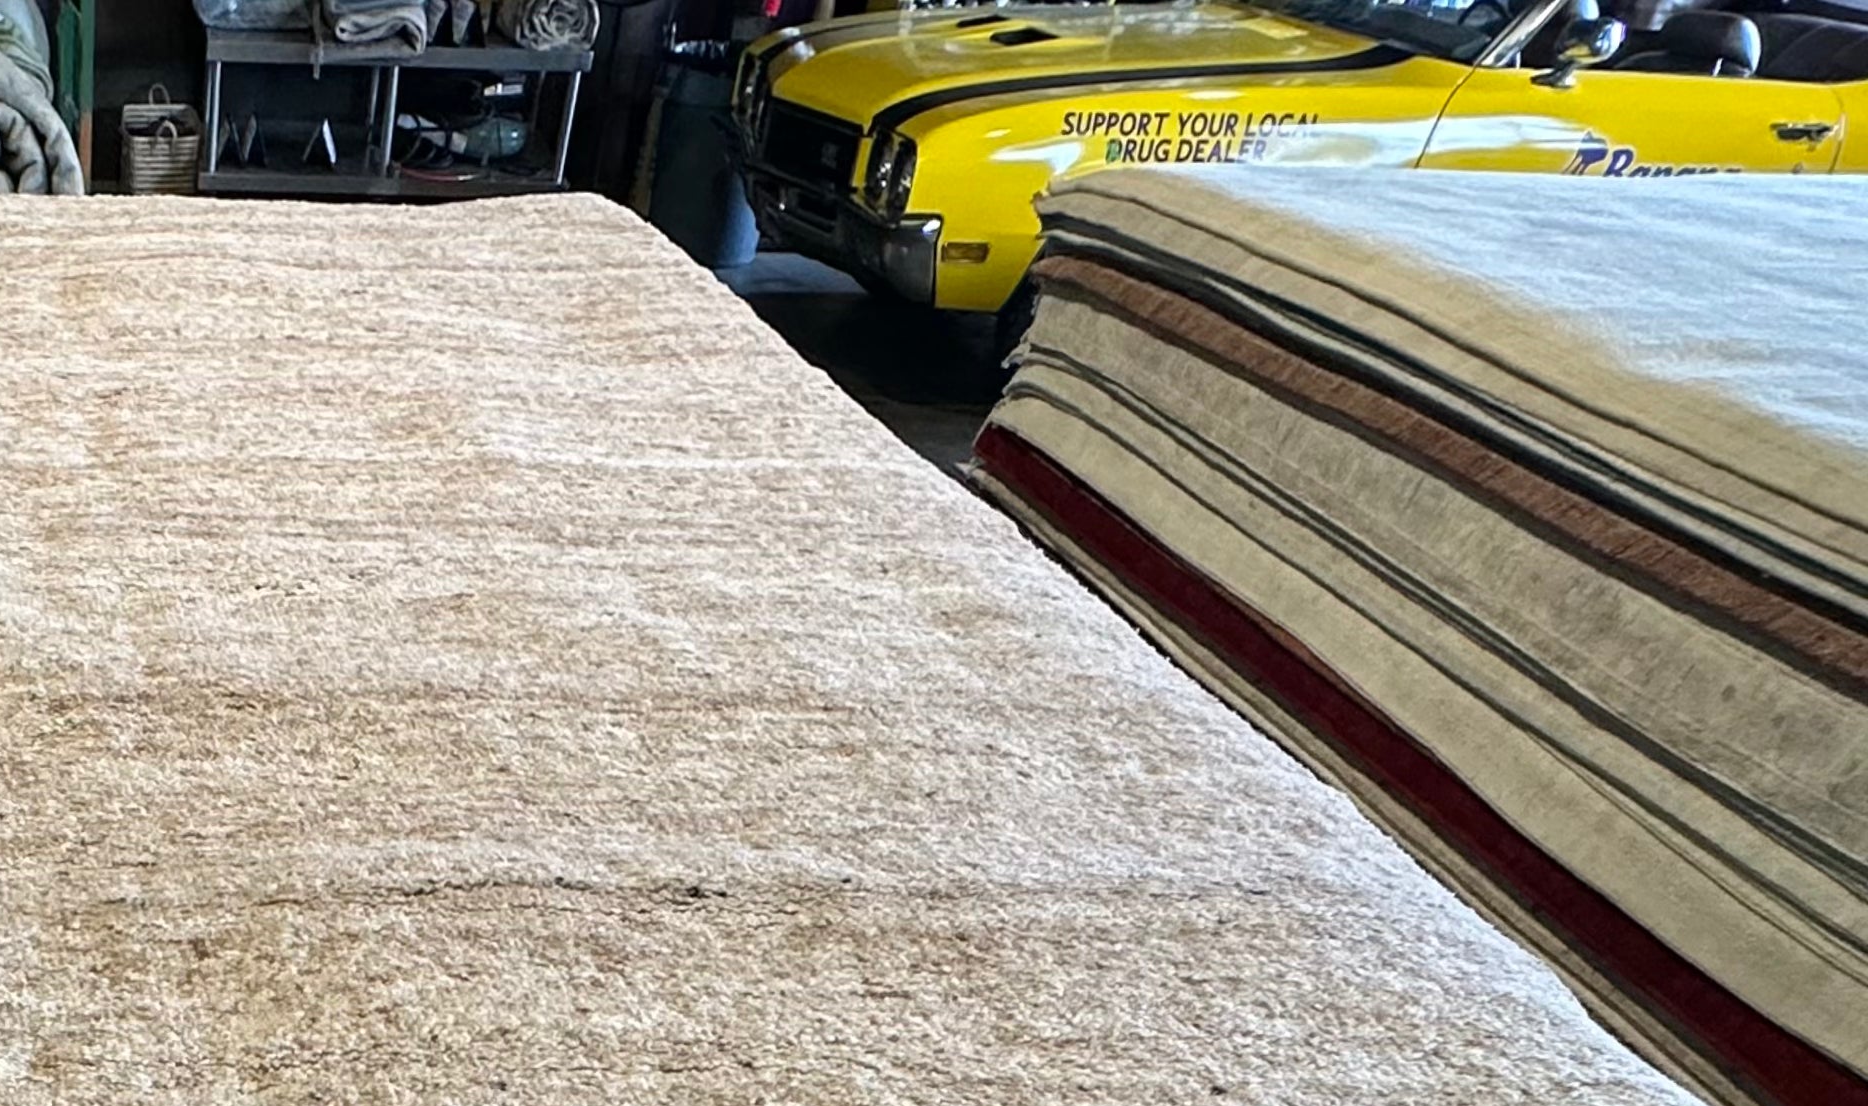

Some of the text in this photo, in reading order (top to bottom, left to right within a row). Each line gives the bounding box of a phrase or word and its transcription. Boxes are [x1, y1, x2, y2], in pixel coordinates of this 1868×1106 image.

[1061, 111, 1322, 138] SUPPORT YOUR LOCAL
[1105, 138, 1267, 164] DRUG DEALER
